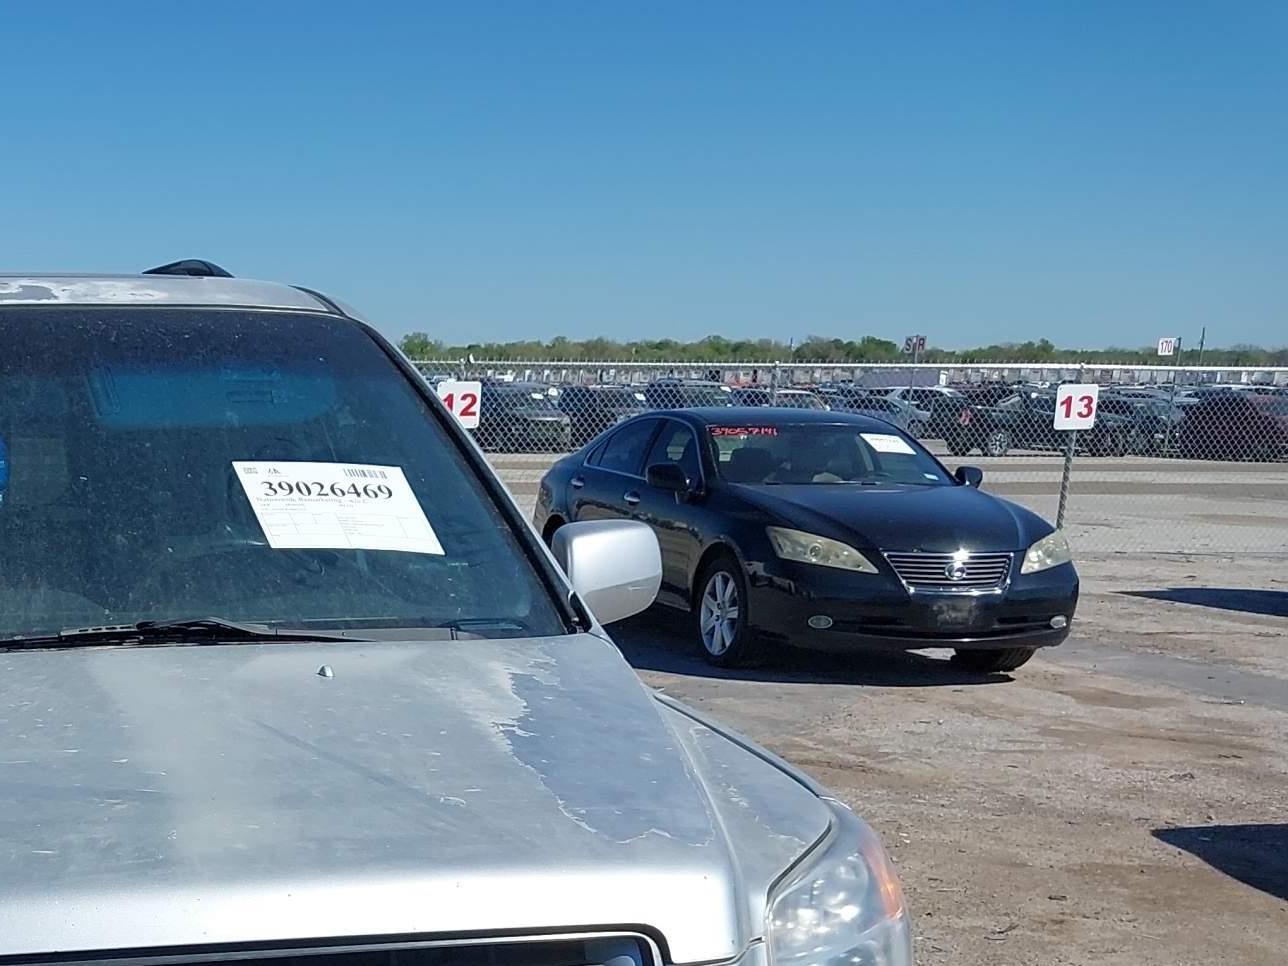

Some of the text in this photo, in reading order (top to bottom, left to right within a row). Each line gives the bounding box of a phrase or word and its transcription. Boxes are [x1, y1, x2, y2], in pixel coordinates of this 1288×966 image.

[1160, 340, 1173, 354] 170
[443, 393, 478, 417] 12
[1059, 394, 1094, 419] 13
[261, 480, 393, 500] 39026469
